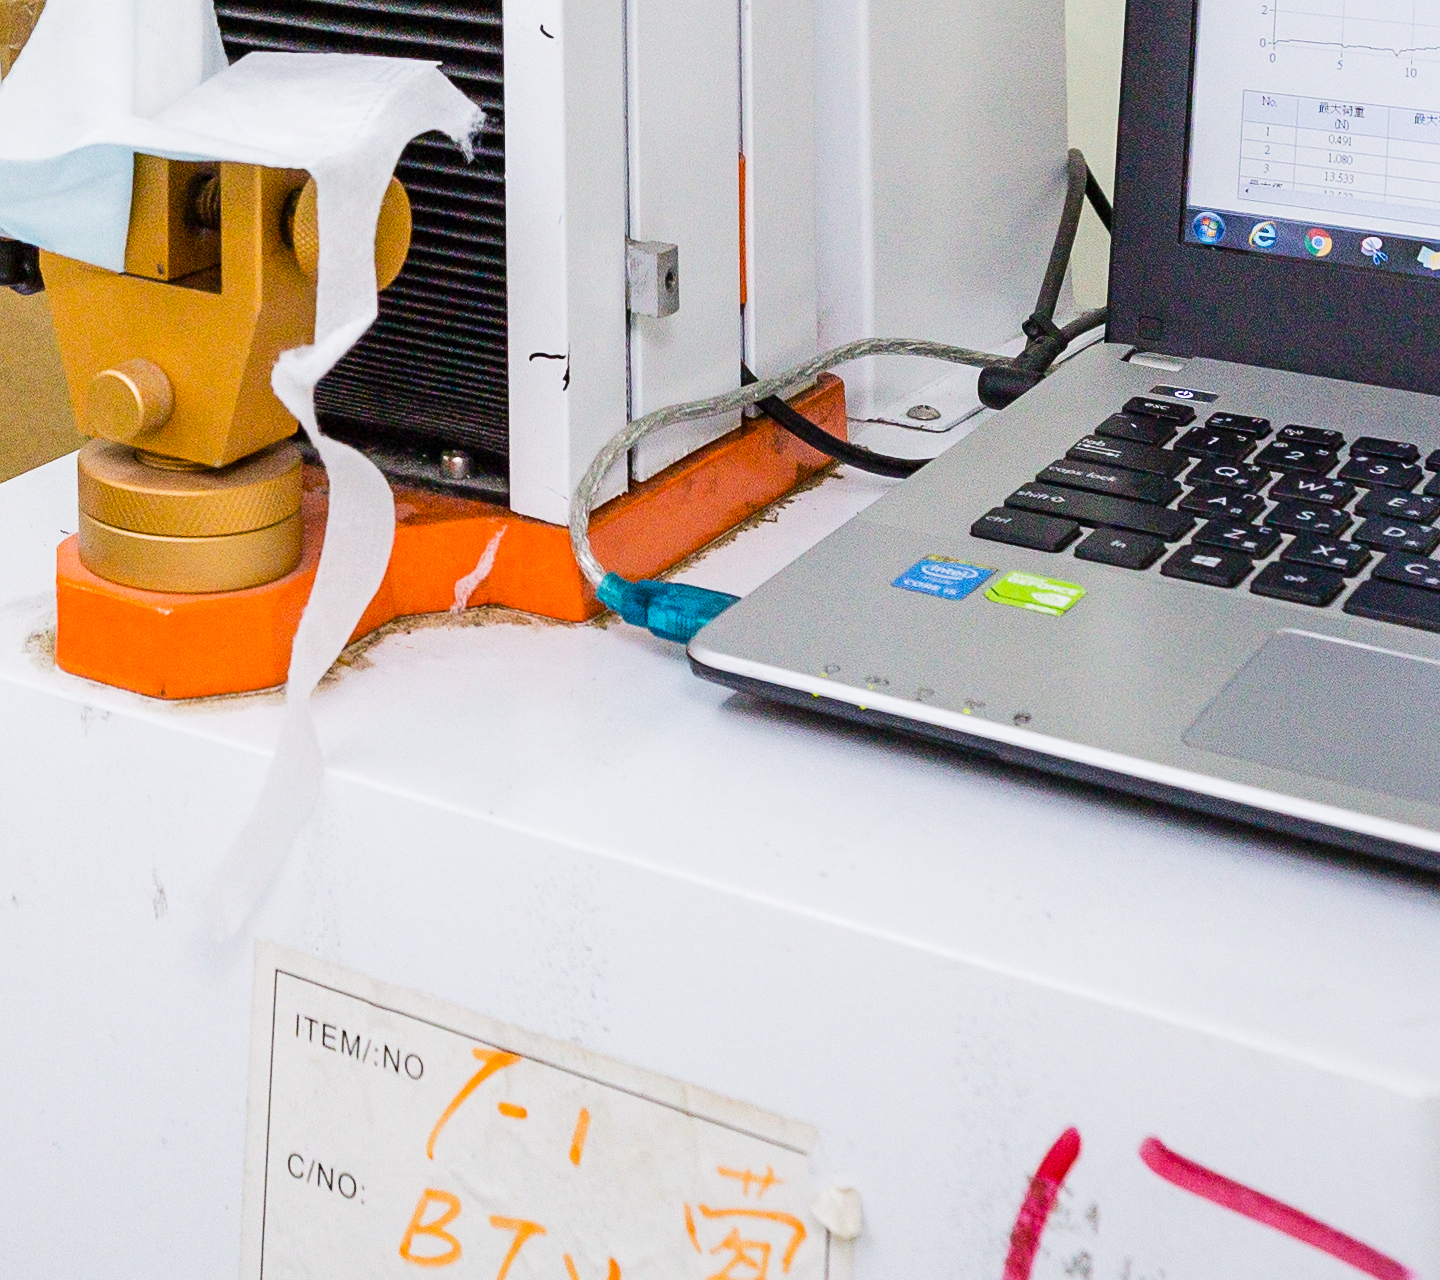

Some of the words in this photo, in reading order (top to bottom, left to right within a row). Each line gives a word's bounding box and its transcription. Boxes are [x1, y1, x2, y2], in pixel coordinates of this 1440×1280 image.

[1261, 5, 1268, 15] 2
[1259, 37, 1267, 48] 0
[1269, 52, 1277, 64] 0
[1336, 59, 1343, 71] 5
[1404, 67, 1417, 79] 10
[1328, 134, 1352, 146] 0.491
[1328, 153, 1353, 165] 1.080
[1324, 171, 1354, 184] 13.533
[1285, 451, 1304, 460] 2
[1215, 466, 1239, 478] Q
[1369, 465, 1389, 475] 3
[1298, 480, 1326, 492] W
[1016, 490, 1051, 501] shift
[1208, 496, 1227, 506] A
[1387, 497, 1408, 508] E
[985, 515, 1012, 524] ctrl
[1296, 510, 1316, 521] S
[1223, 528, 1247, 540] Z
[1382, 526, 1406, 538] D
[1312, 544, 1336, 556] X
[1404, 564, 1428, 575] C
[294, 1012, 425, 1081] ITEM/:NO
[426, 1046, 590, 1165] 7-1
[287, 1152, 367, 1206] C/NO:
